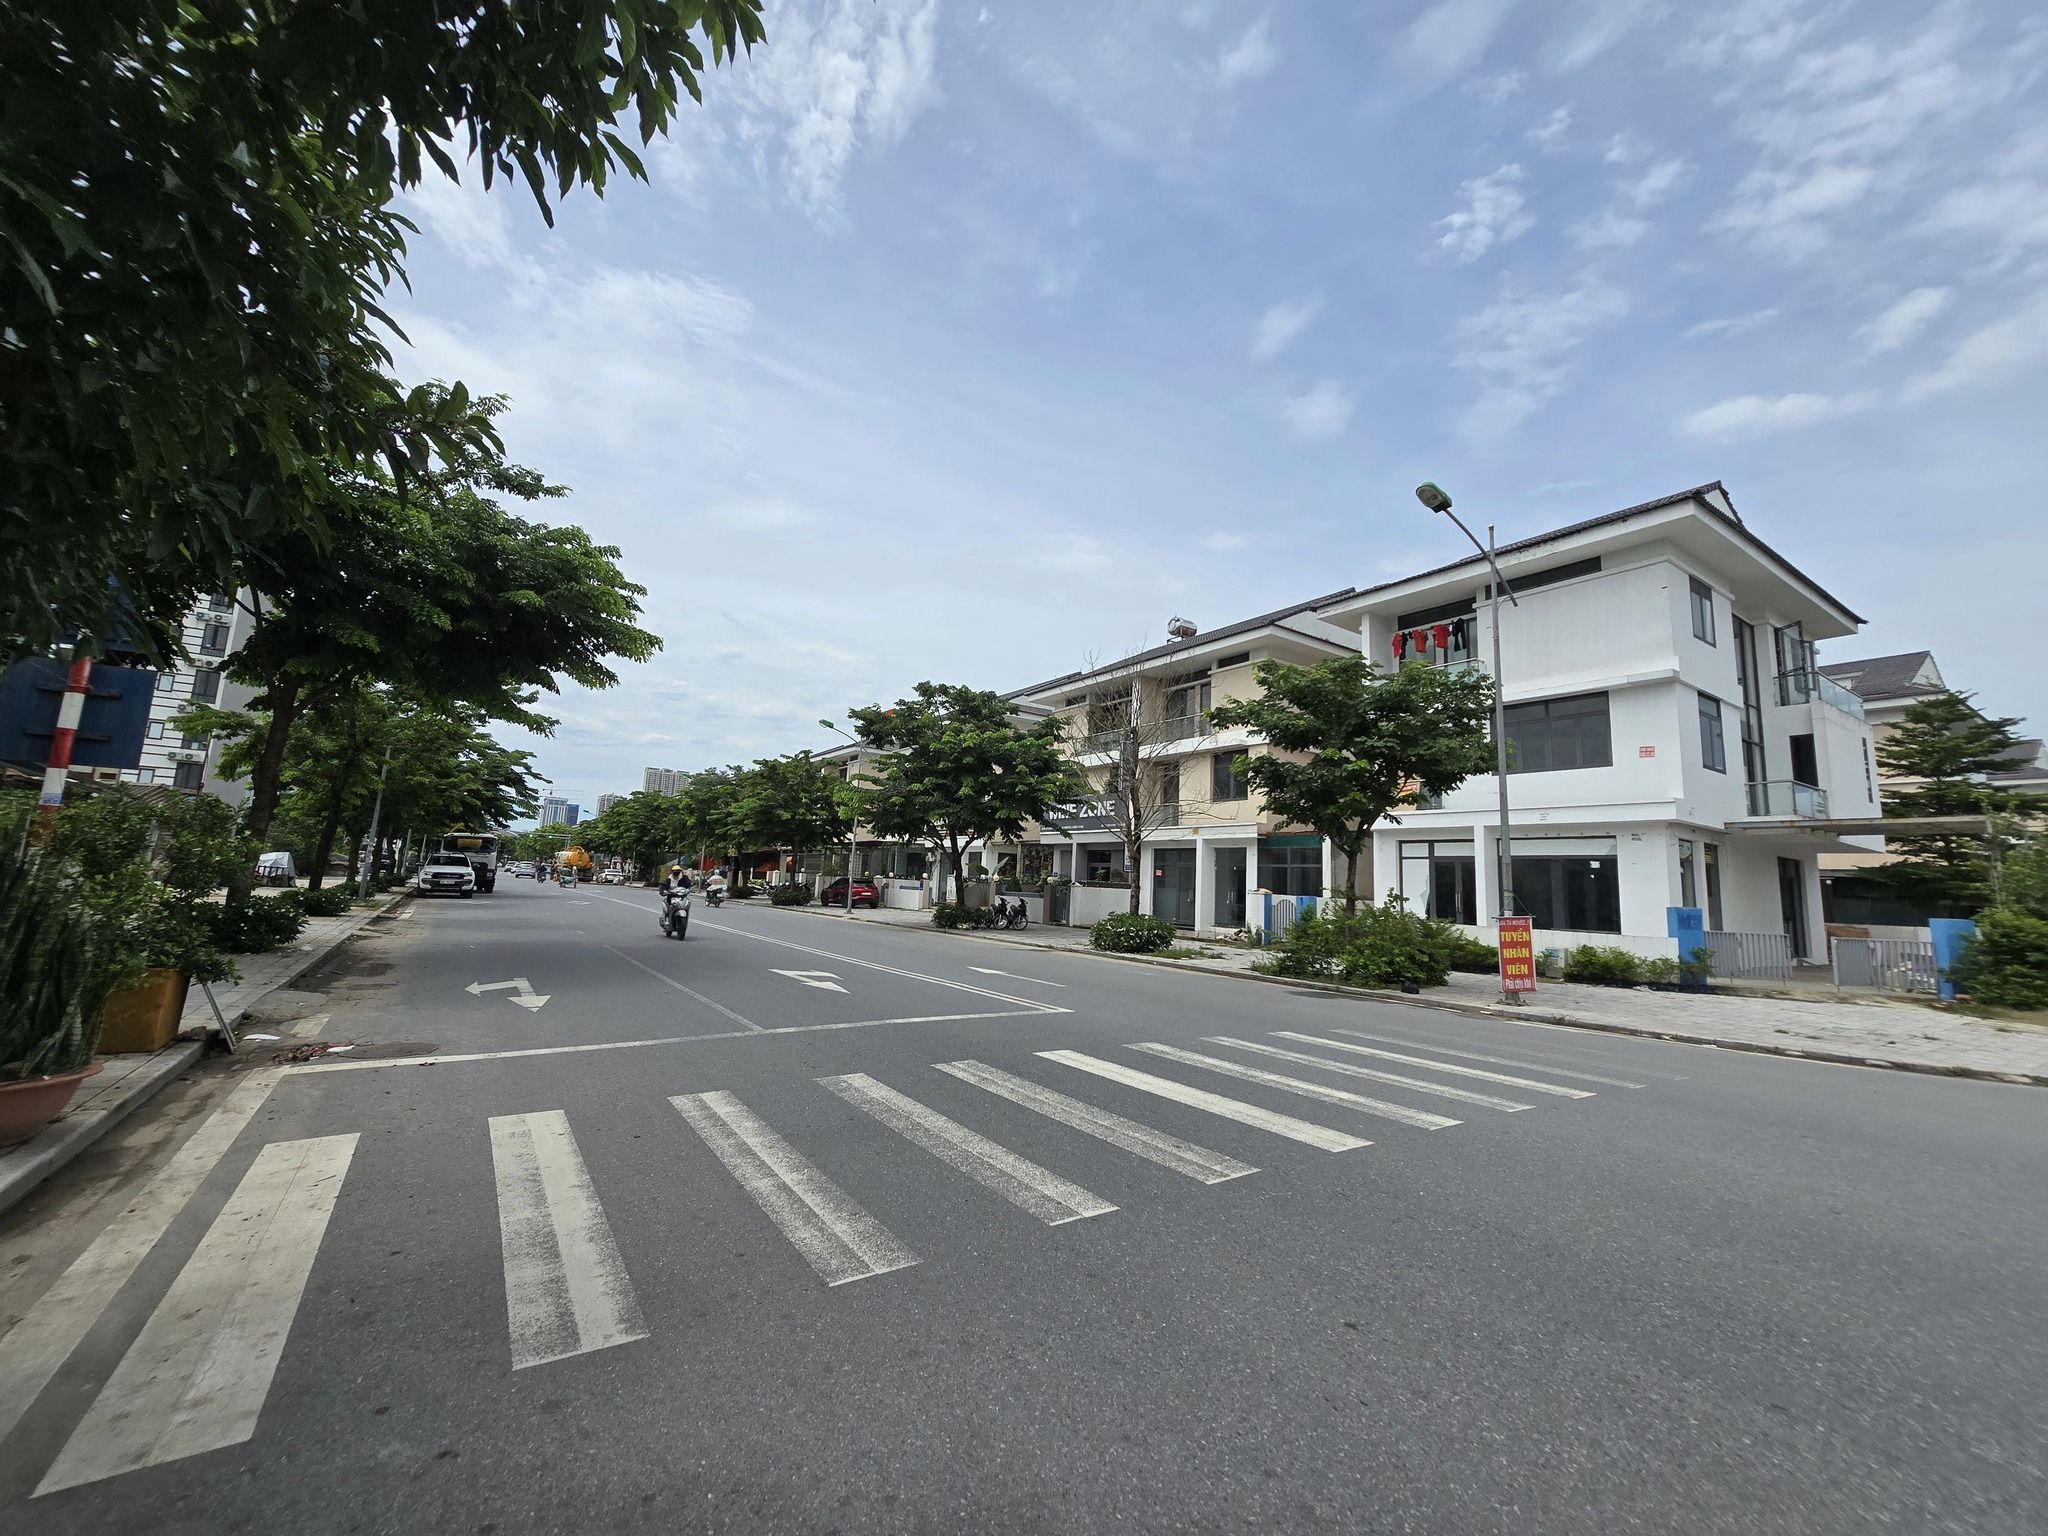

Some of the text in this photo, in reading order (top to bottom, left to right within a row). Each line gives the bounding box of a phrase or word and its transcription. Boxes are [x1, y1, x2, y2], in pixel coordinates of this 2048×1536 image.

[1079, 800, 1116, 818] ZONE
[1501, 927, 1530, 942] TUYỂN
[1503, 946, 1530, 959] NHÂN
[1506, 962, 1529, 975] VIÊN
